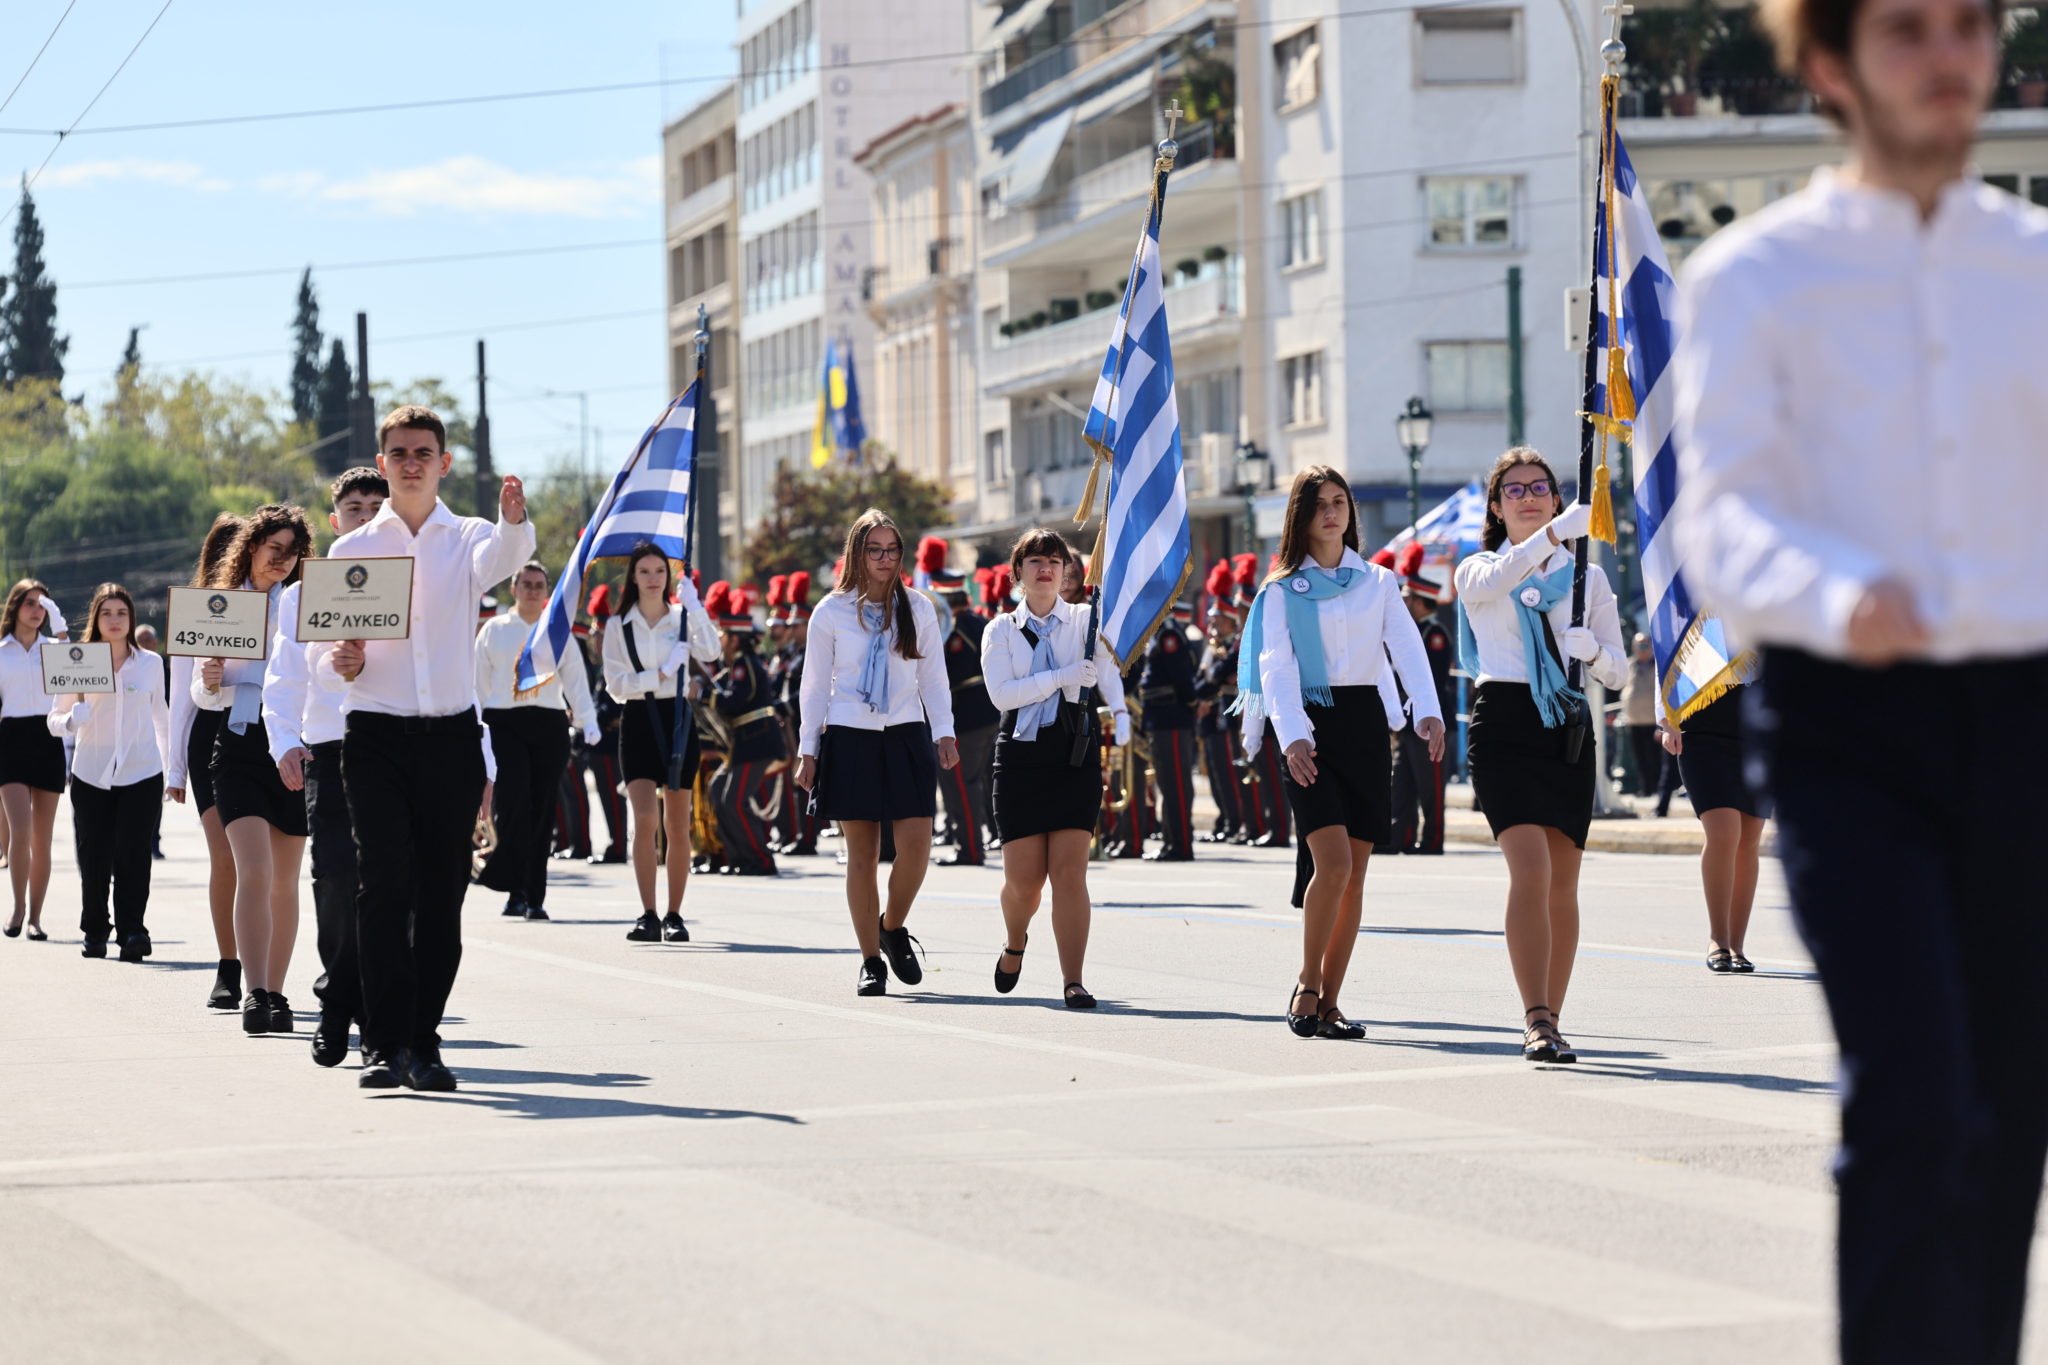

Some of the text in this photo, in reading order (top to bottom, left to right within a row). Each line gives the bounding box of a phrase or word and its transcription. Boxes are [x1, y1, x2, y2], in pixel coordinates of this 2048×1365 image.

[831, 43, 851, 189] HOTEL
[342, 613, 400, 628] ΛΥΚΕΙΟ
[205, 635, 258, 649] ΛΥΚΕΙΟ
[72, 676, 109, 687] ΛΥΚΕΙΟ
